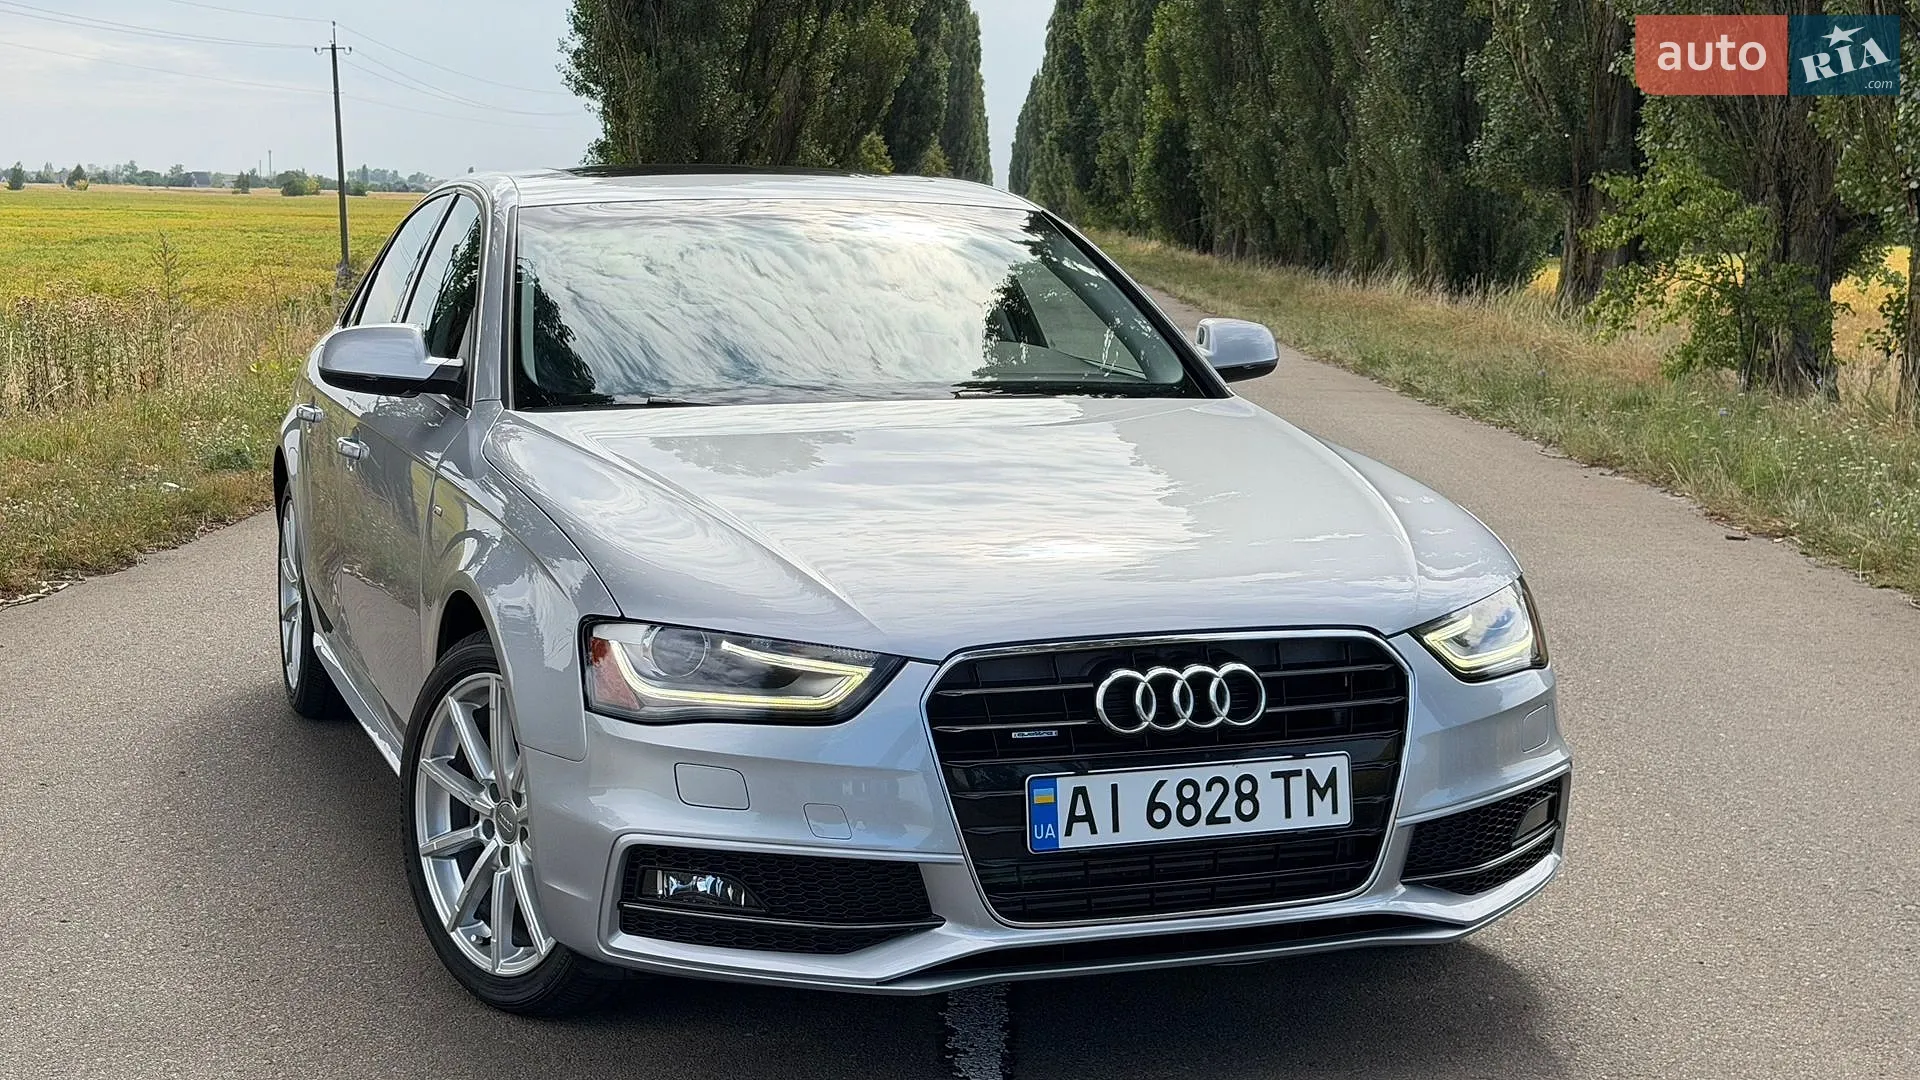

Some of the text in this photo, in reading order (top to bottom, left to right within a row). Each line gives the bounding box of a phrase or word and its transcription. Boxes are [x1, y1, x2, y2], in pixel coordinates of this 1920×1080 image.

[1064, 766, 1339, 837] AI 6828 TM
[1034, 824, 1056, 840] UA
